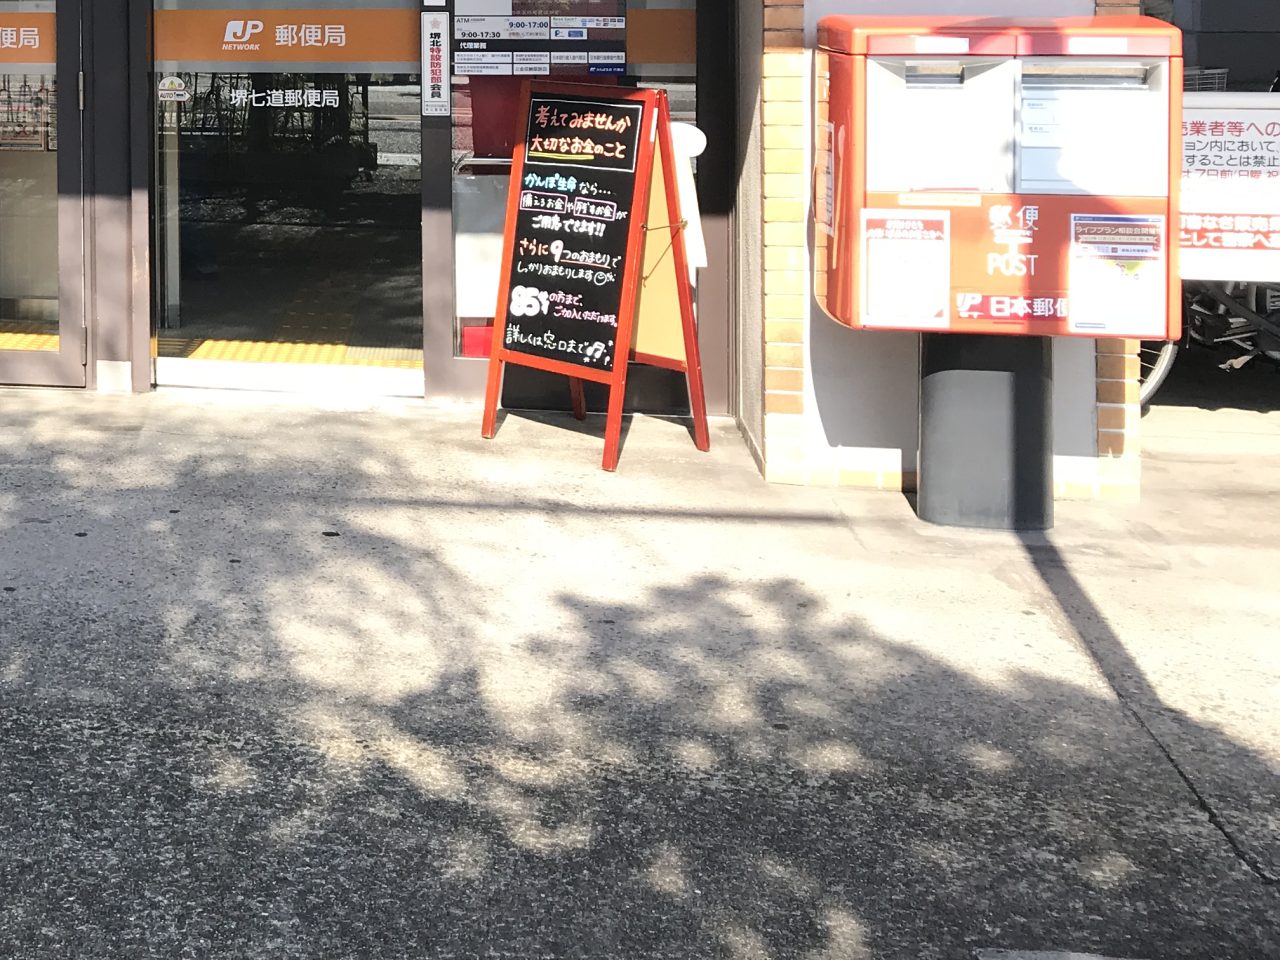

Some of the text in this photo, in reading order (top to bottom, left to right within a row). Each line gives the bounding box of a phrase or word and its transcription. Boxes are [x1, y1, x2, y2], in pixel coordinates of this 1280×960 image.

[275, 24, 346, 46] 郵便局
[230, 90, 339, 108] 堺七道郵便局
[535, 105, 631, 133] 考えてみませんか
[530, 134, 626, 158] 大切なお金のこと
[987, 252, 1039, 276] POST
[506, 323, 589, 354] 詳しくは窓口まで
